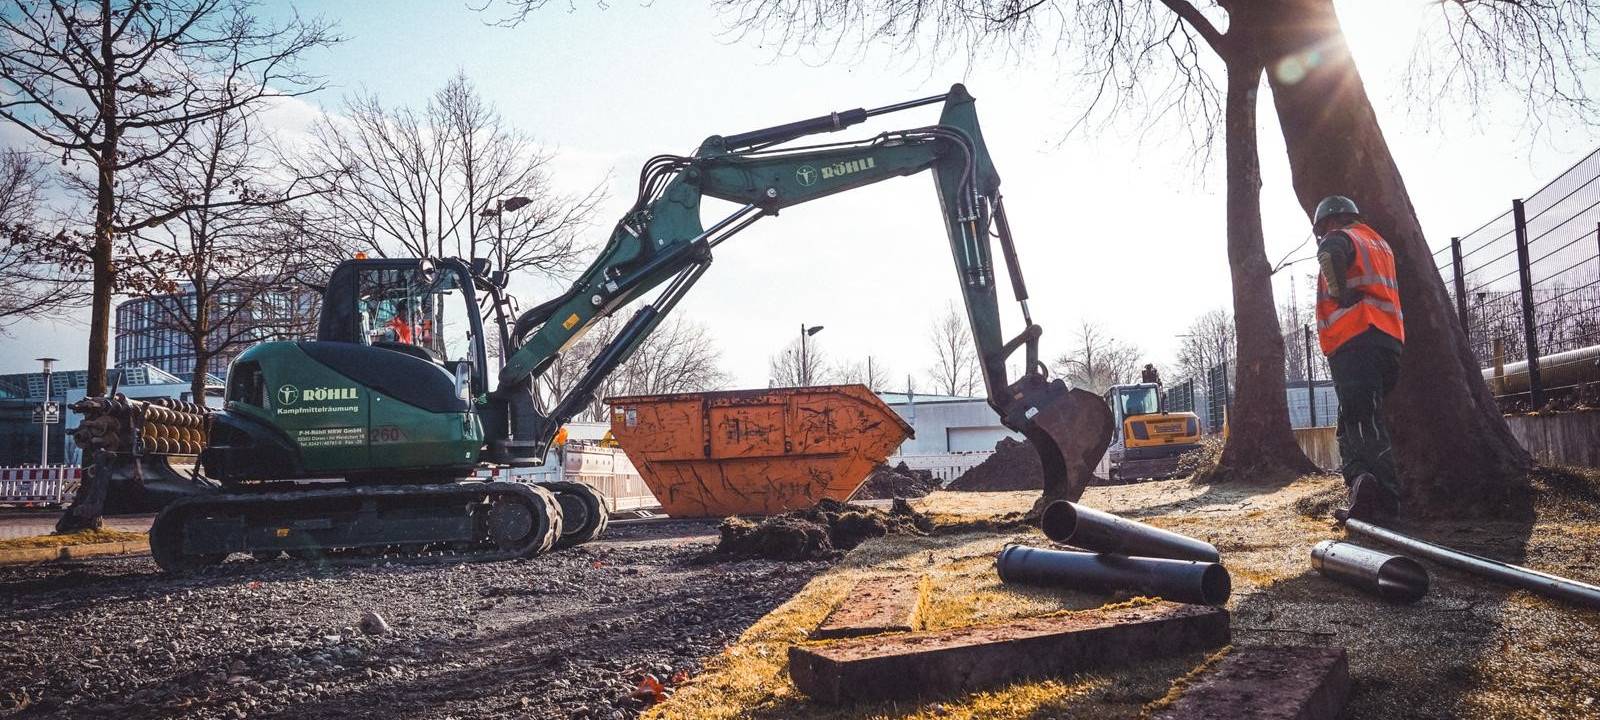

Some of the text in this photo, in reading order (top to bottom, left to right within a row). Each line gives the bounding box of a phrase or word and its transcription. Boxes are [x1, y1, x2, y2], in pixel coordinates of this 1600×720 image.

[821, 157, 875, 179] RÖHLL
[303, 387, 359, 401] RÖHLL
[277, 406, 359, 415] Kampfmittelräumung
[371, 427, 400, 442] 260
